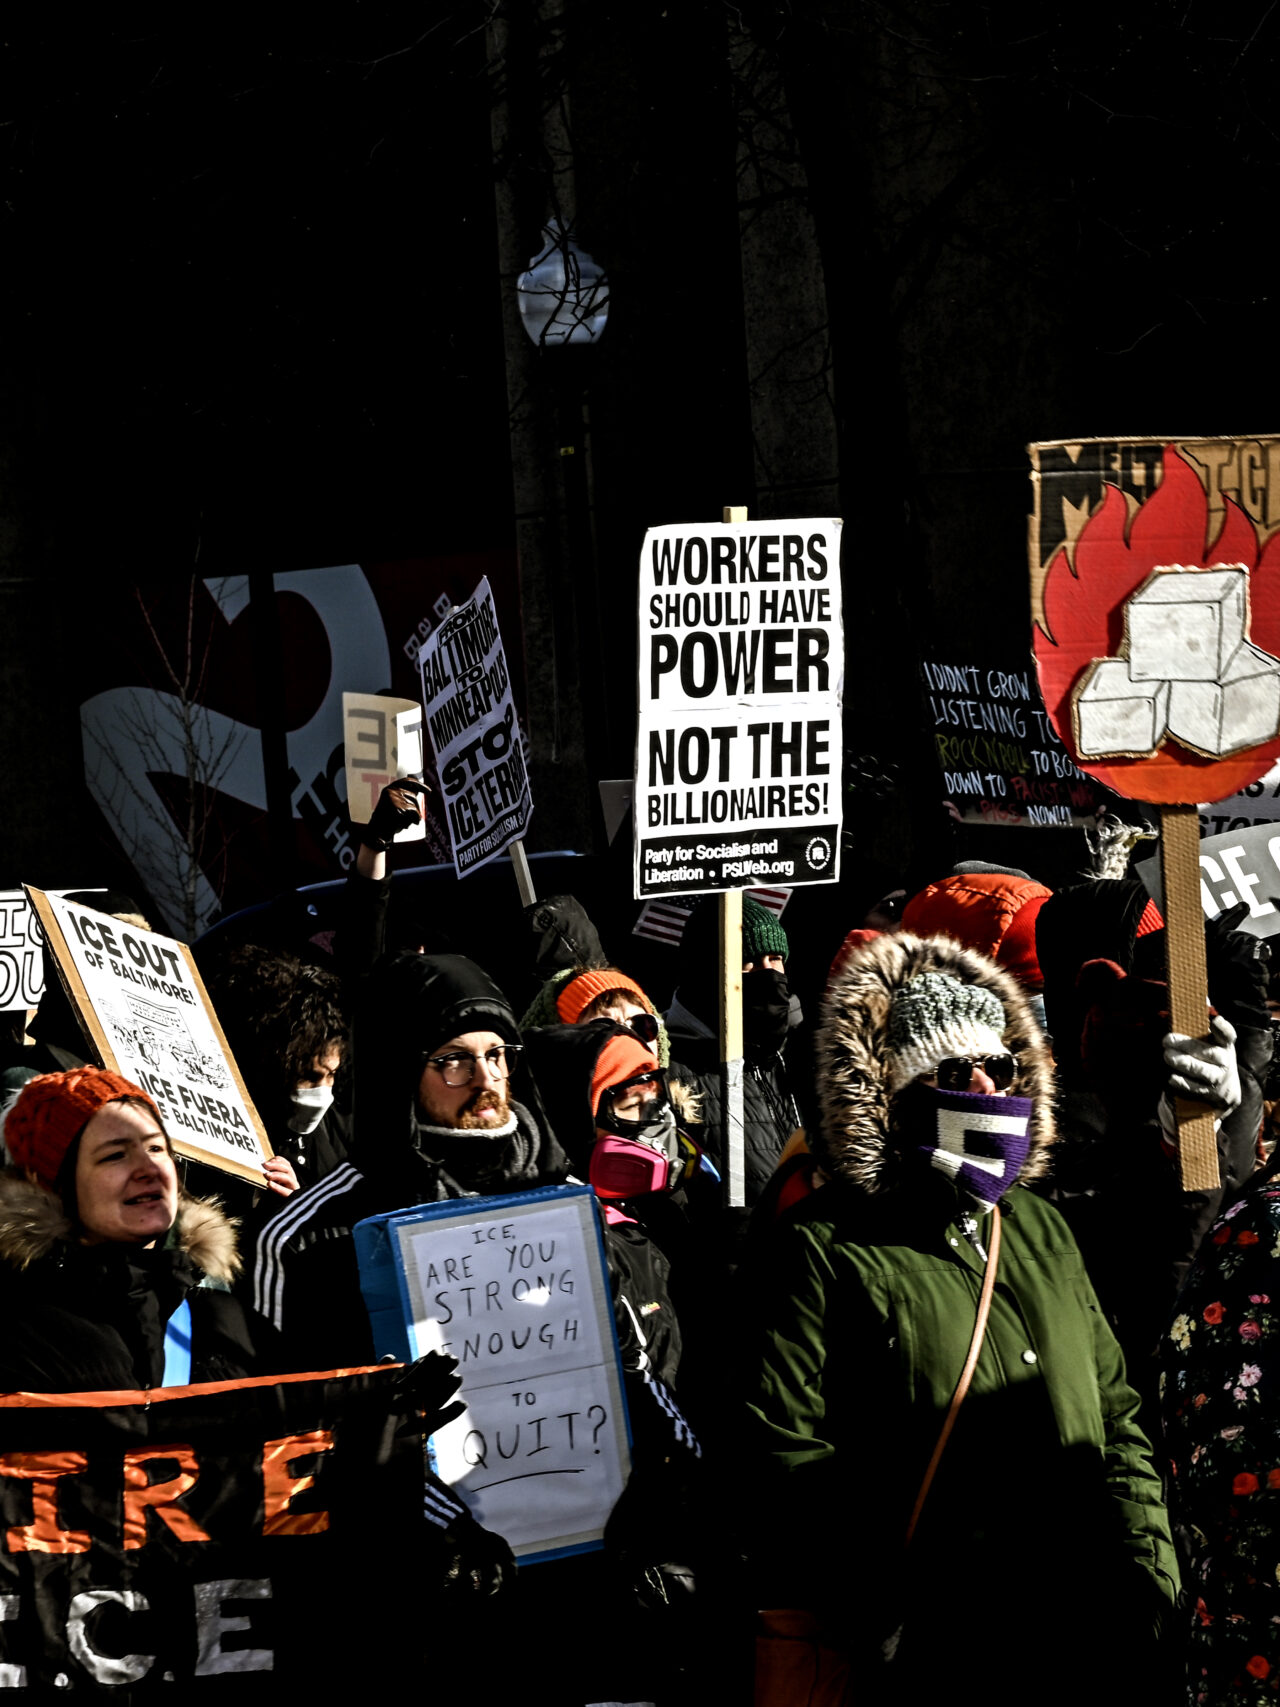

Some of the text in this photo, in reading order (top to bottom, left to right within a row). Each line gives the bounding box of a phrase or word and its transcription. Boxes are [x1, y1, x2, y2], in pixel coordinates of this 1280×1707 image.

[652, 533, 828, 586] WORKERS
[439, 602, 478, 646] FROM
[649, 588, 832, 629] SHOULD HAVE
[422, 593, 499, 706] BALTIMORE
[650, 628, 830, 700] POWER
[457, 665, 483, 688] TO
[923, 661, 1030, 701] I DIDN'T GROW
[929, 695, 1027, 739] LISTENING
[442, 703, 514, 797] STOP
[648, 719, 830, 787] NOT THE
[935, 733, 988, 768] ROCK
[1030, 750, 1050, 776] TO
[648, 783, 829, 828] BILLIONAIRES!
[944, 769, 985, 797] DOWN
[984, 772, 1007, 798] TO
[448, 786, 486, 846] ICE
[459, 843, 480, 867] PARTY
[480, 836, 493, 853] FOR
[645, 839, 778, 866] Party for Socialism and
[645, 867, 704, 884] Liberation
[1200, 845, 1277, 919] CE
[67, 910, 184, 983] ICE OUT
[84, 950, 197, 1006] OF BALTIMORE!
[175, 1108, 258, 1155] BALTIMORE!
[180, 1086, 250, 1132] FUERA
[426, 1240, 556, 1289] ARE YOU
[435, 1270, 575, 1325] STRONG
[512, 1391, 537, 1407] TO
[463, 1405, 607, 1470] QUIT?
